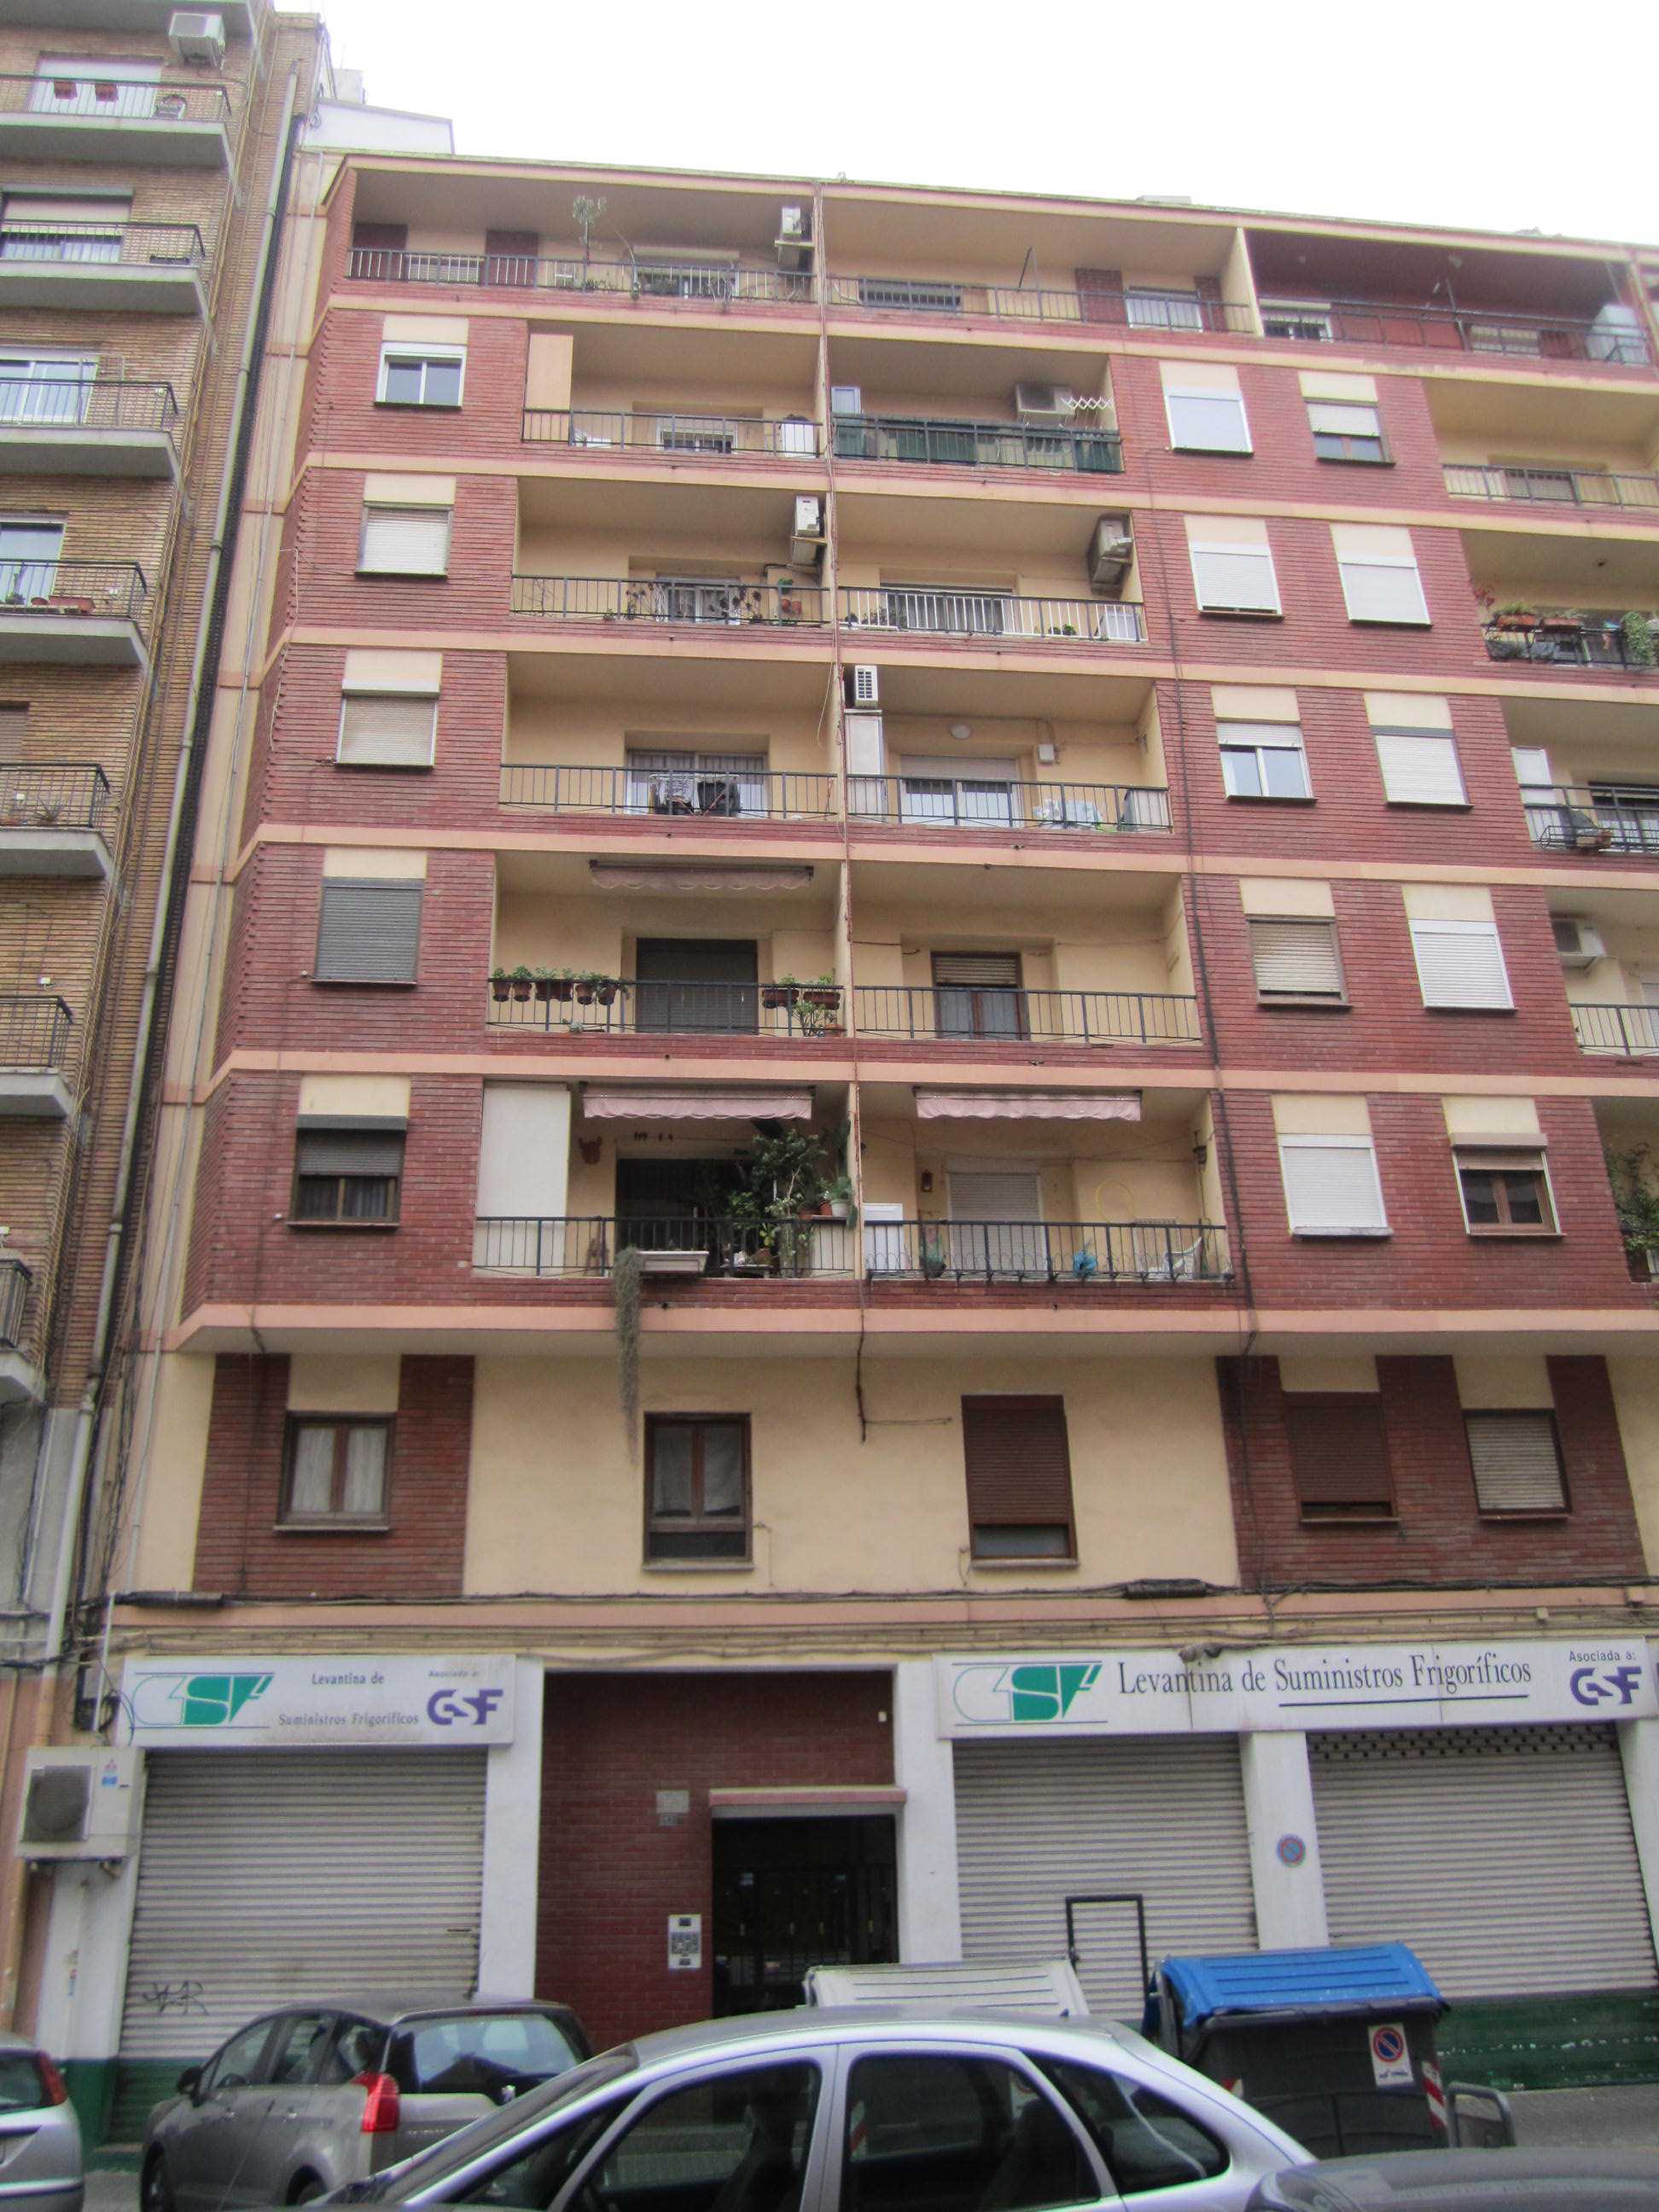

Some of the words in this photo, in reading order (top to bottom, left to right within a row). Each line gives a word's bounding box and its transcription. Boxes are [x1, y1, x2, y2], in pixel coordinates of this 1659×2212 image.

[1569, 1650, 1620, 1662] Asociada
[1626, 1651, 1636, 1661] a:
[311, 1673, 366, 1685] Levantina
[370, 1672, 384, 1684] de
[1118, 1662, 1233, 1694] Levantina
[1242, 1661, 1266, 1691] de
[1273, 1658, 1403, 1691] Suministros
[1410, 1652, 1532, 1694] Frigoríficos
[1569, 1666, 1642, 1706] GSF
[278, 1713, 346, 1726] Suministros
[427, 1689, 504, 1726] GSF
